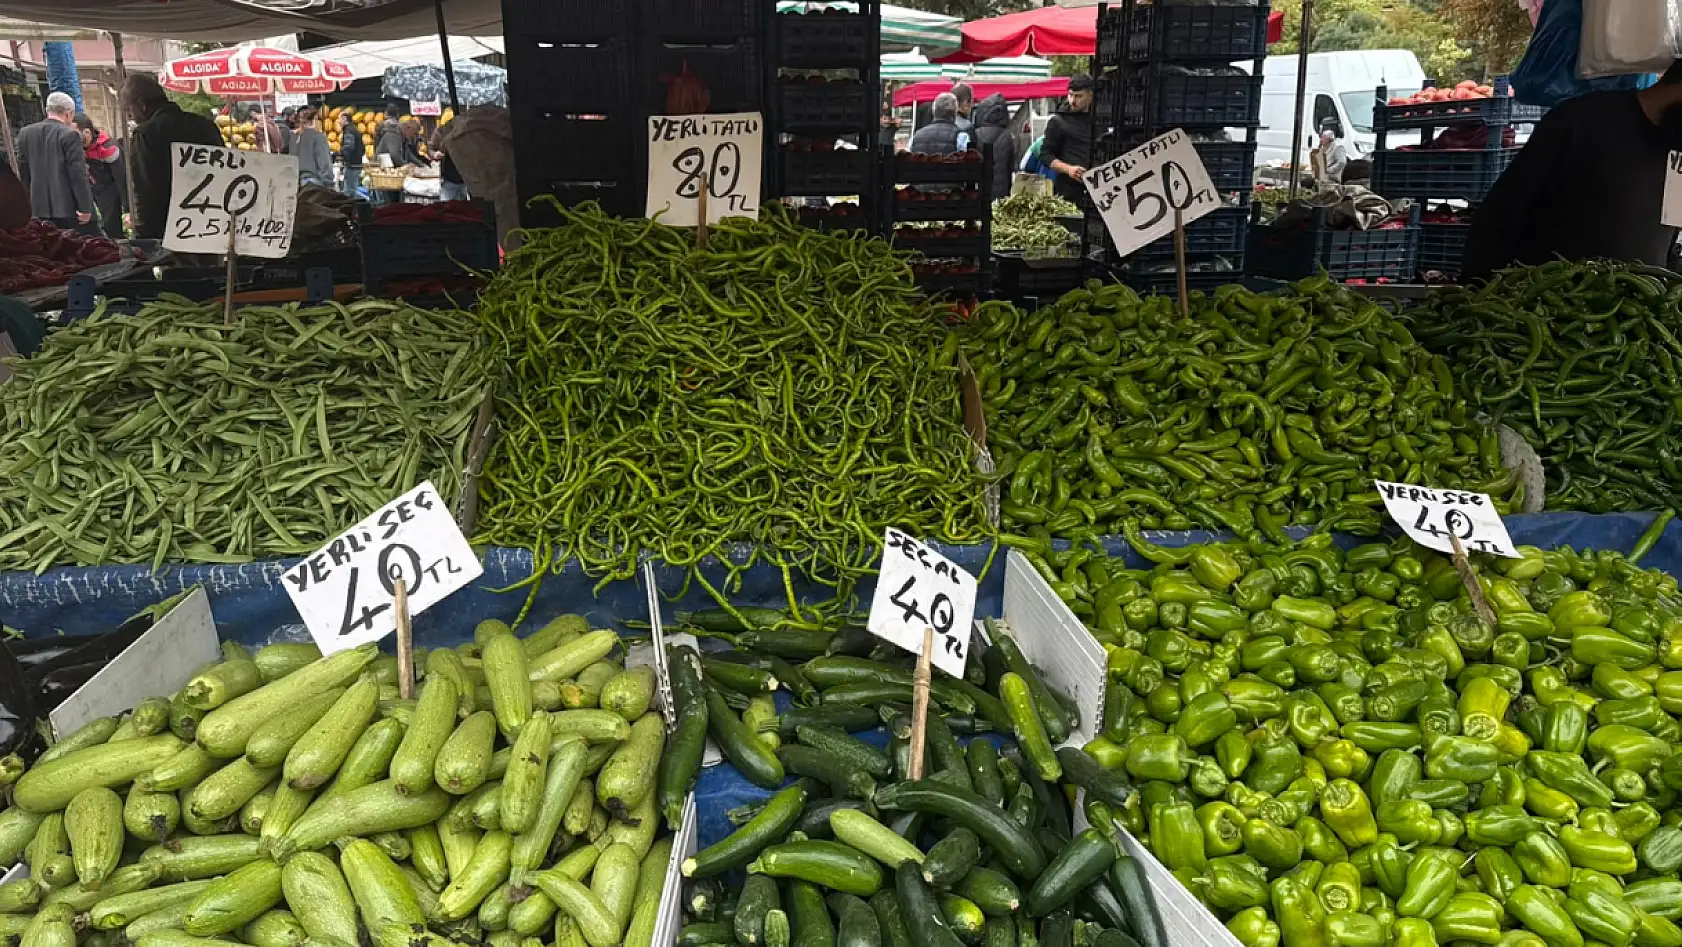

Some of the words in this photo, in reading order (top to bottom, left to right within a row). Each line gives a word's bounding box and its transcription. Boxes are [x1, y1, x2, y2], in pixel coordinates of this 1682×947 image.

[183, 62, 220, 74] ALGIDA
[260, 61, 302, 73] ALGIDA
[179, 173, 259, 216] 40
[672, 141, 741, 199] 80
[728, 194, 756, 211] TL
[1125, 160, 1194, 232] 50
[1413, 504, 1474, 540] 40
[338, 543, 423, 636] 40
[424, 555, 463, 584] TL
[889, 575, 954, 635] 40
[945, 633, 964, 659] TL
